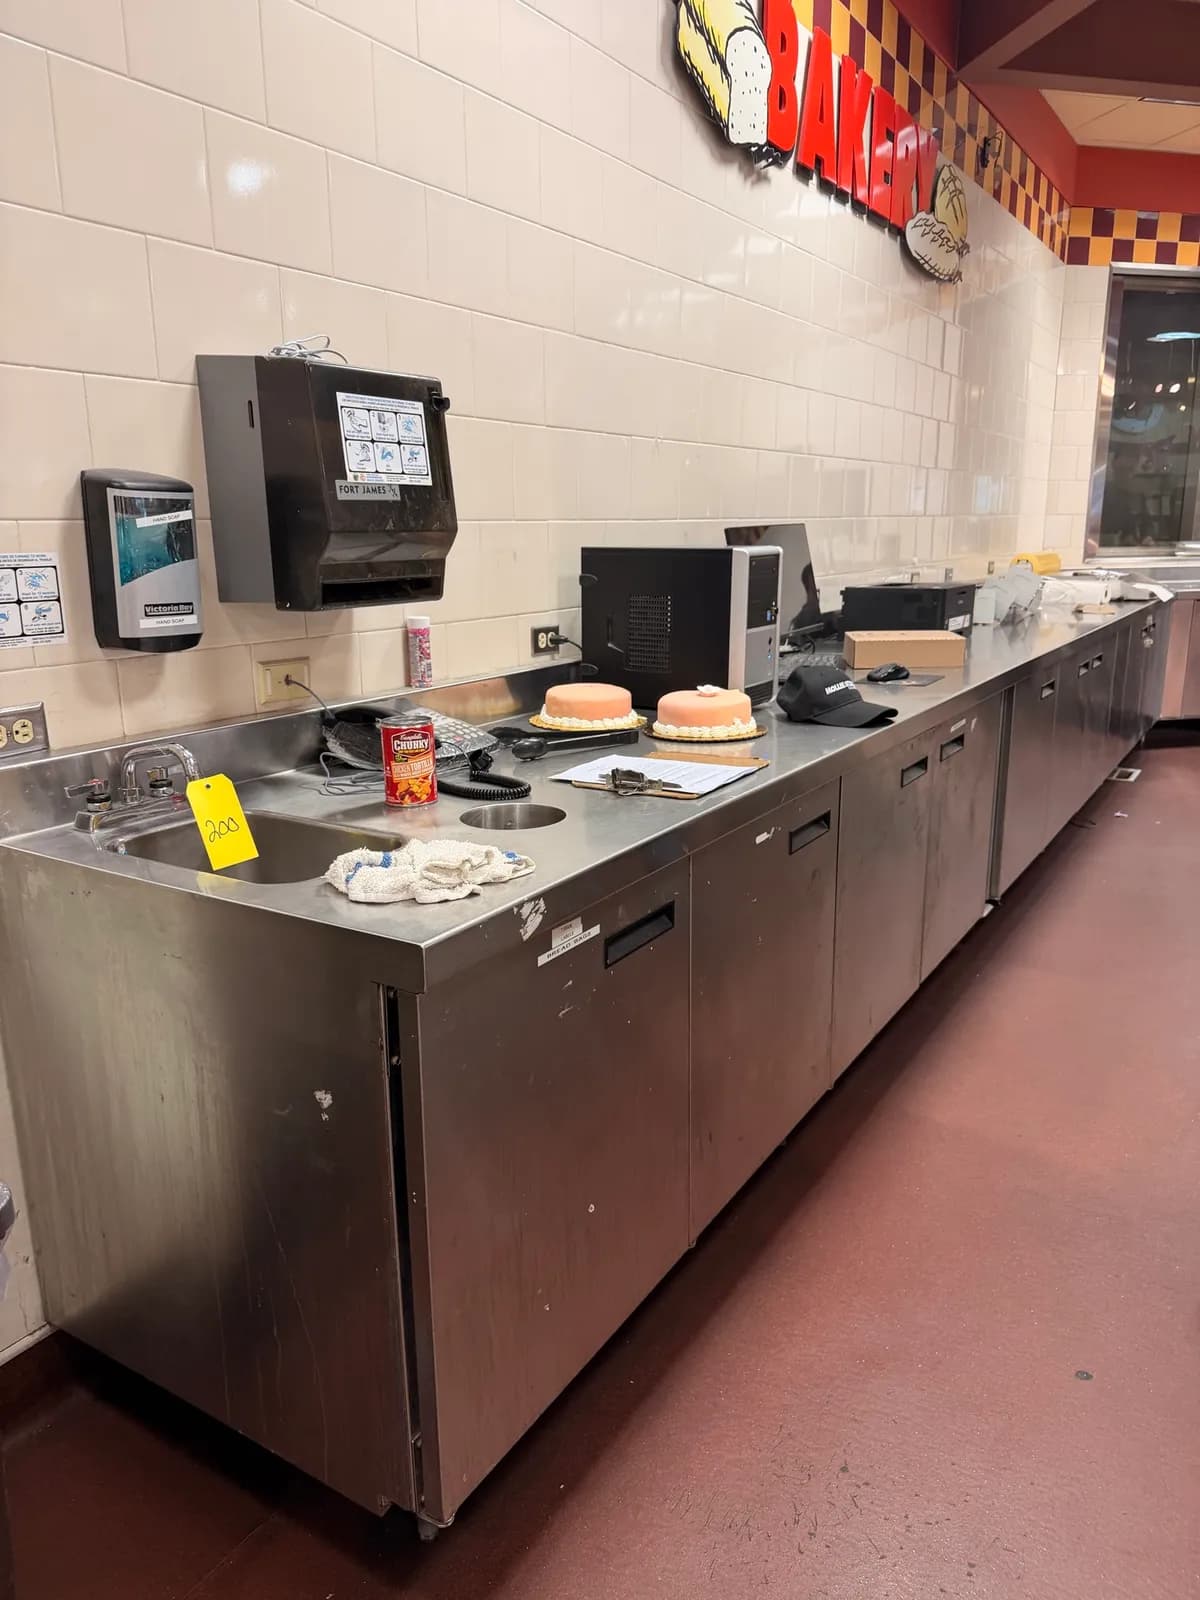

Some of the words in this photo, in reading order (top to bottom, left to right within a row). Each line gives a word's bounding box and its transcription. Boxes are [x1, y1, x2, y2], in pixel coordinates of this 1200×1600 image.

[762, 0, 939, 231] BAKERY
[339, 485, 359, 494] FORT
[362, 485, 386, 495] JAMES
[145, 604, 178, 613] Victoria
[394, 738, 429, 751] CHUNKY
[205, 816, 240, 843] 200
[547, 942, 571, 959] BREAD
[573, 931, 591, 944] BAGS
